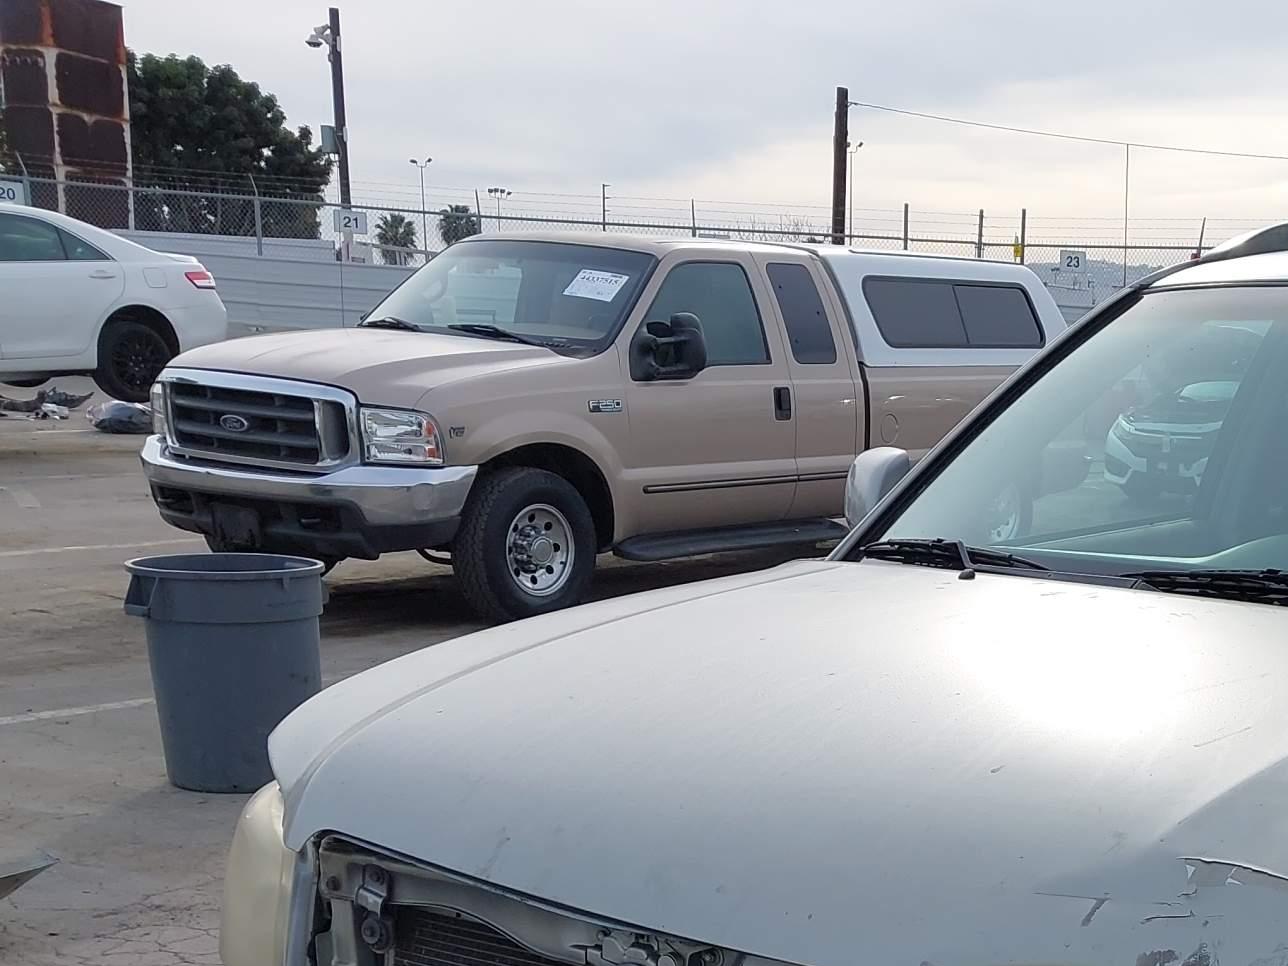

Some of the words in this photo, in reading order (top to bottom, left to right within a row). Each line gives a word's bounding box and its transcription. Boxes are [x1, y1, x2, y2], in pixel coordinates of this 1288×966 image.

[0, 186, 16, 200] 20
[343, 216, 359, 229] 21
[1066, 255, 1080, 268] 23
